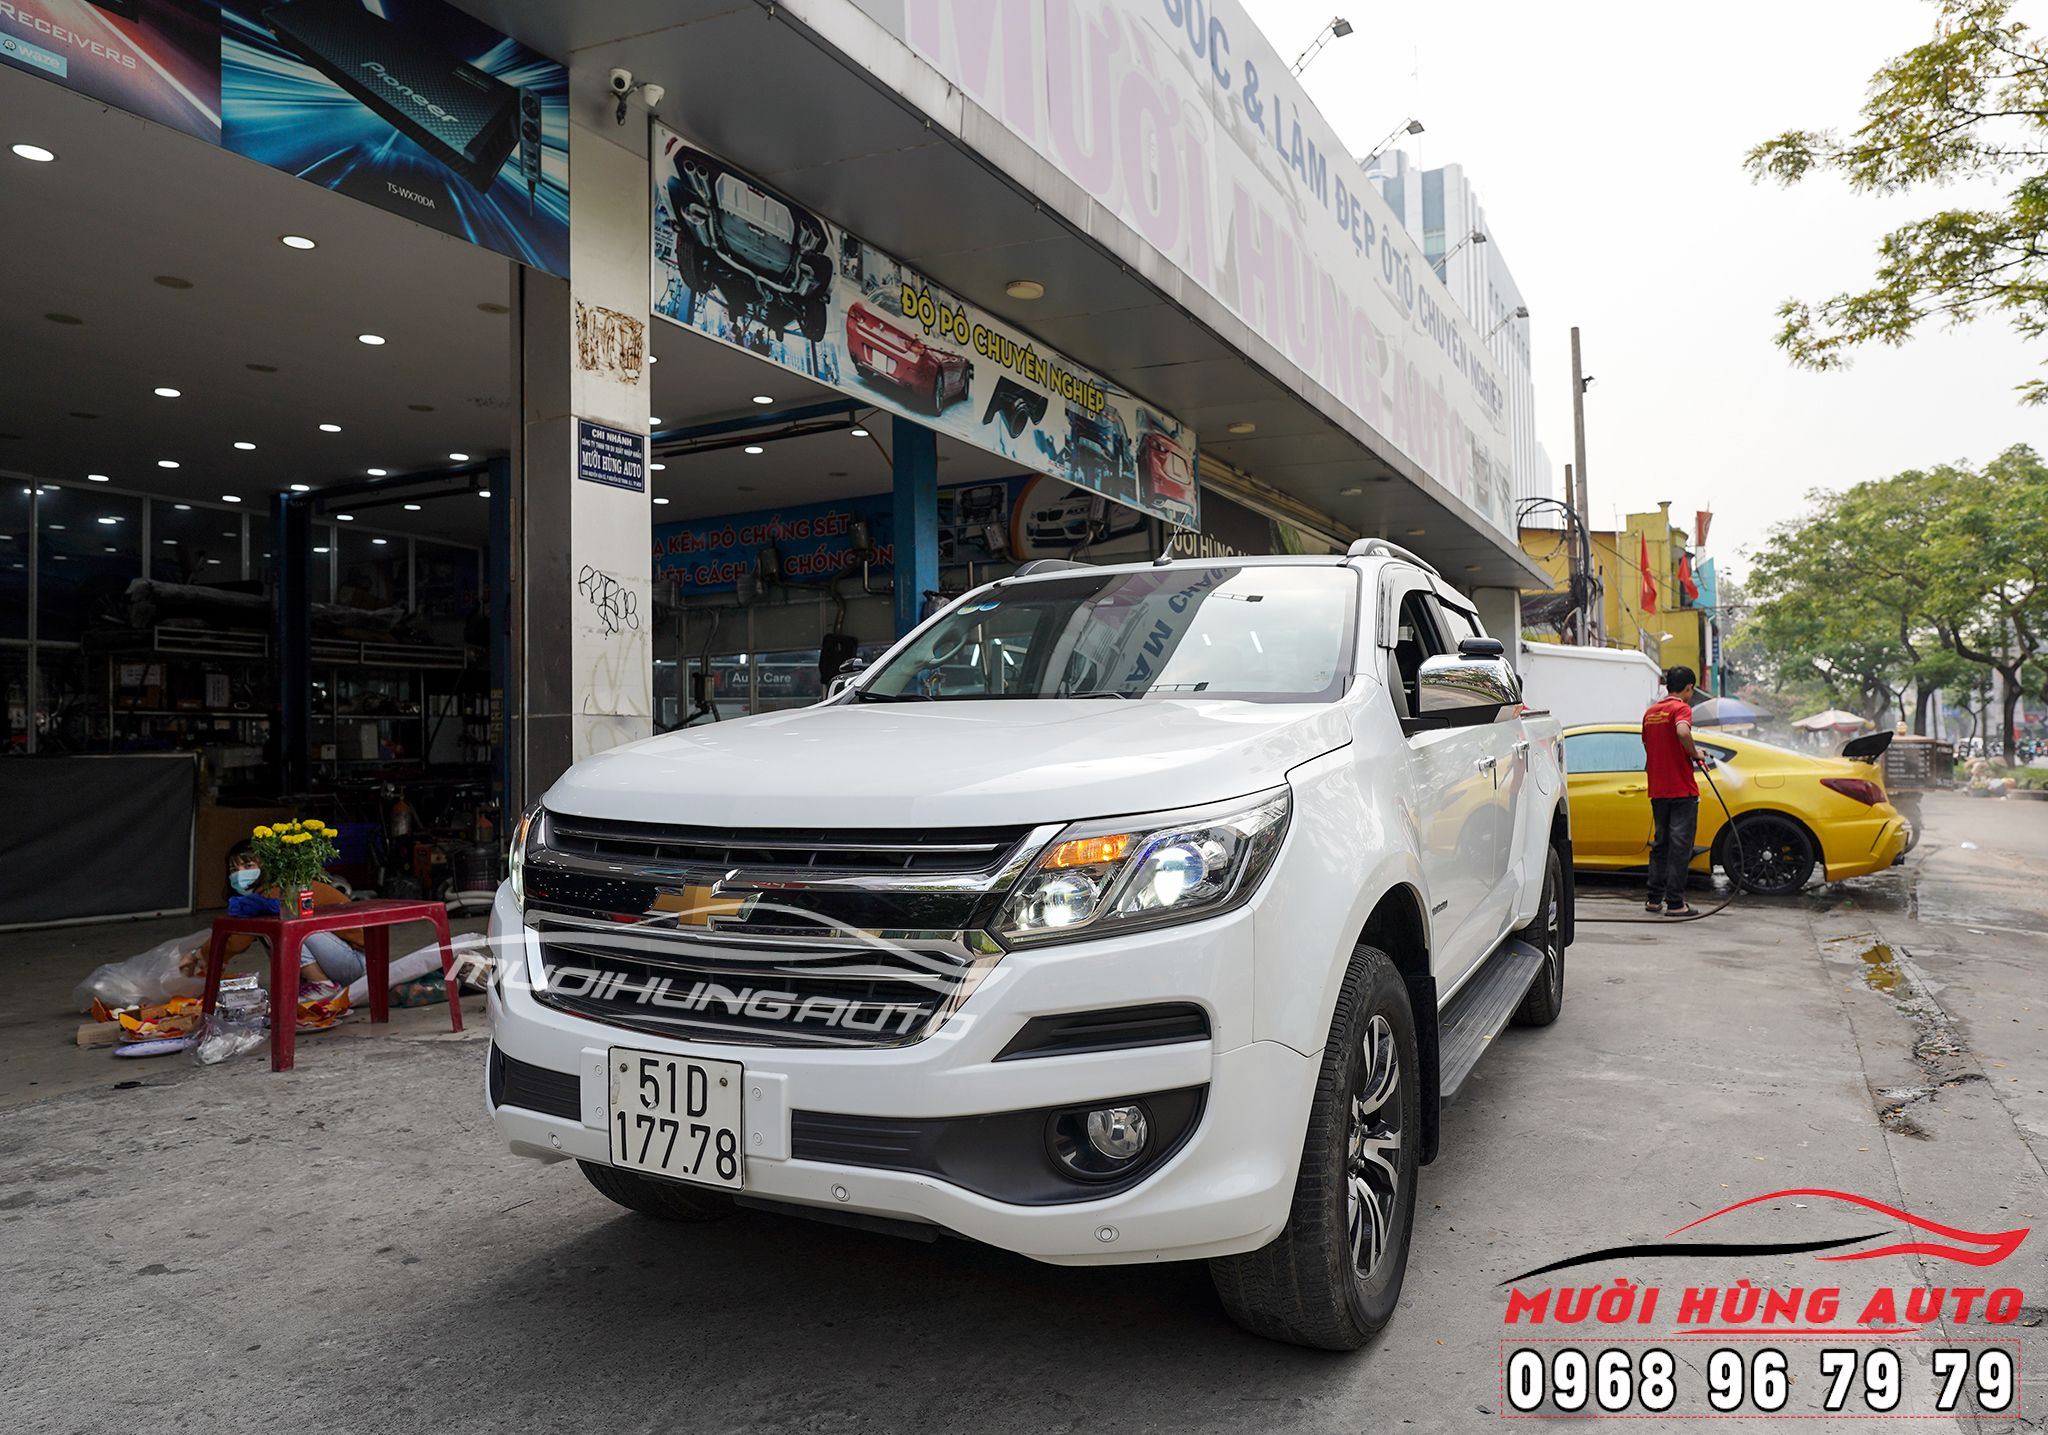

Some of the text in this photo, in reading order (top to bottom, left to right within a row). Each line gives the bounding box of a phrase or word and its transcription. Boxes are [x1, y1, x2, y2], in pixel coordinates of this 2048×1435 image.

[0, 1, 137, 69] RECEIVERS
[18, 45, 60, 69] waze
[360, 61, 459, 123] Pioneer
[386, 181, 436, 209] TS-WX70DA
[1243, 60, 1265, 136] &
[1274, 93, 1329, 210] LÀM
[1335, 173, 1376, 260] ĐẸP
[1418, 283, 1468, 379] CHUYÊN
[901, 283, 1106, 419] ĐỘ PÔ CHUYÊN NGHIỆP
[591, 428, 632, 447] CHI NHÁNH
[582, 449, 642, 479] MƯỜI HÙNG AUTO
[709, 524, 736, 549] PÔ
[739, 513, 810, 545] CHỐNG
[813, 509, 850, 537] SÉT
[732, 672, 760, 683] Auo
[763, 672, 791, 683] Care
[640, 1058, 708, 1117] 51D
[617, 1111, 737, 1180] 177.78
